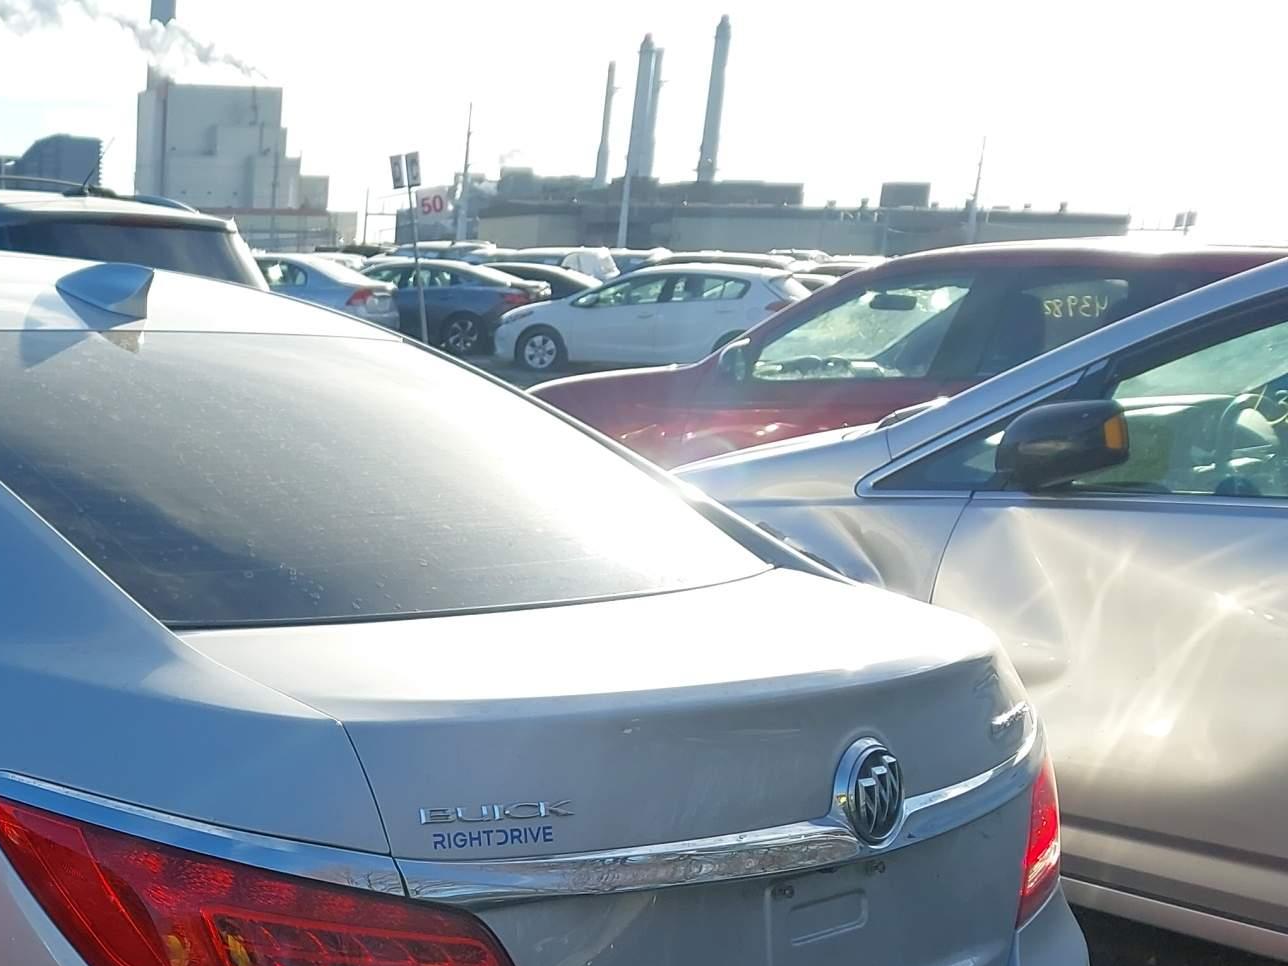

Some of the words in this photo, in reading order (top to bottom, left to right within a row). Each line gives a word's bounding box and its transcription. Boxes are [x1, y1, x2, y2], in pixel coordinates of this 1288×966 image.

[421, 195, 443, 214] 50
[420, 799, 575, 825] BUICK
[432, 826, 553, 850] RIGHTDRIVE
